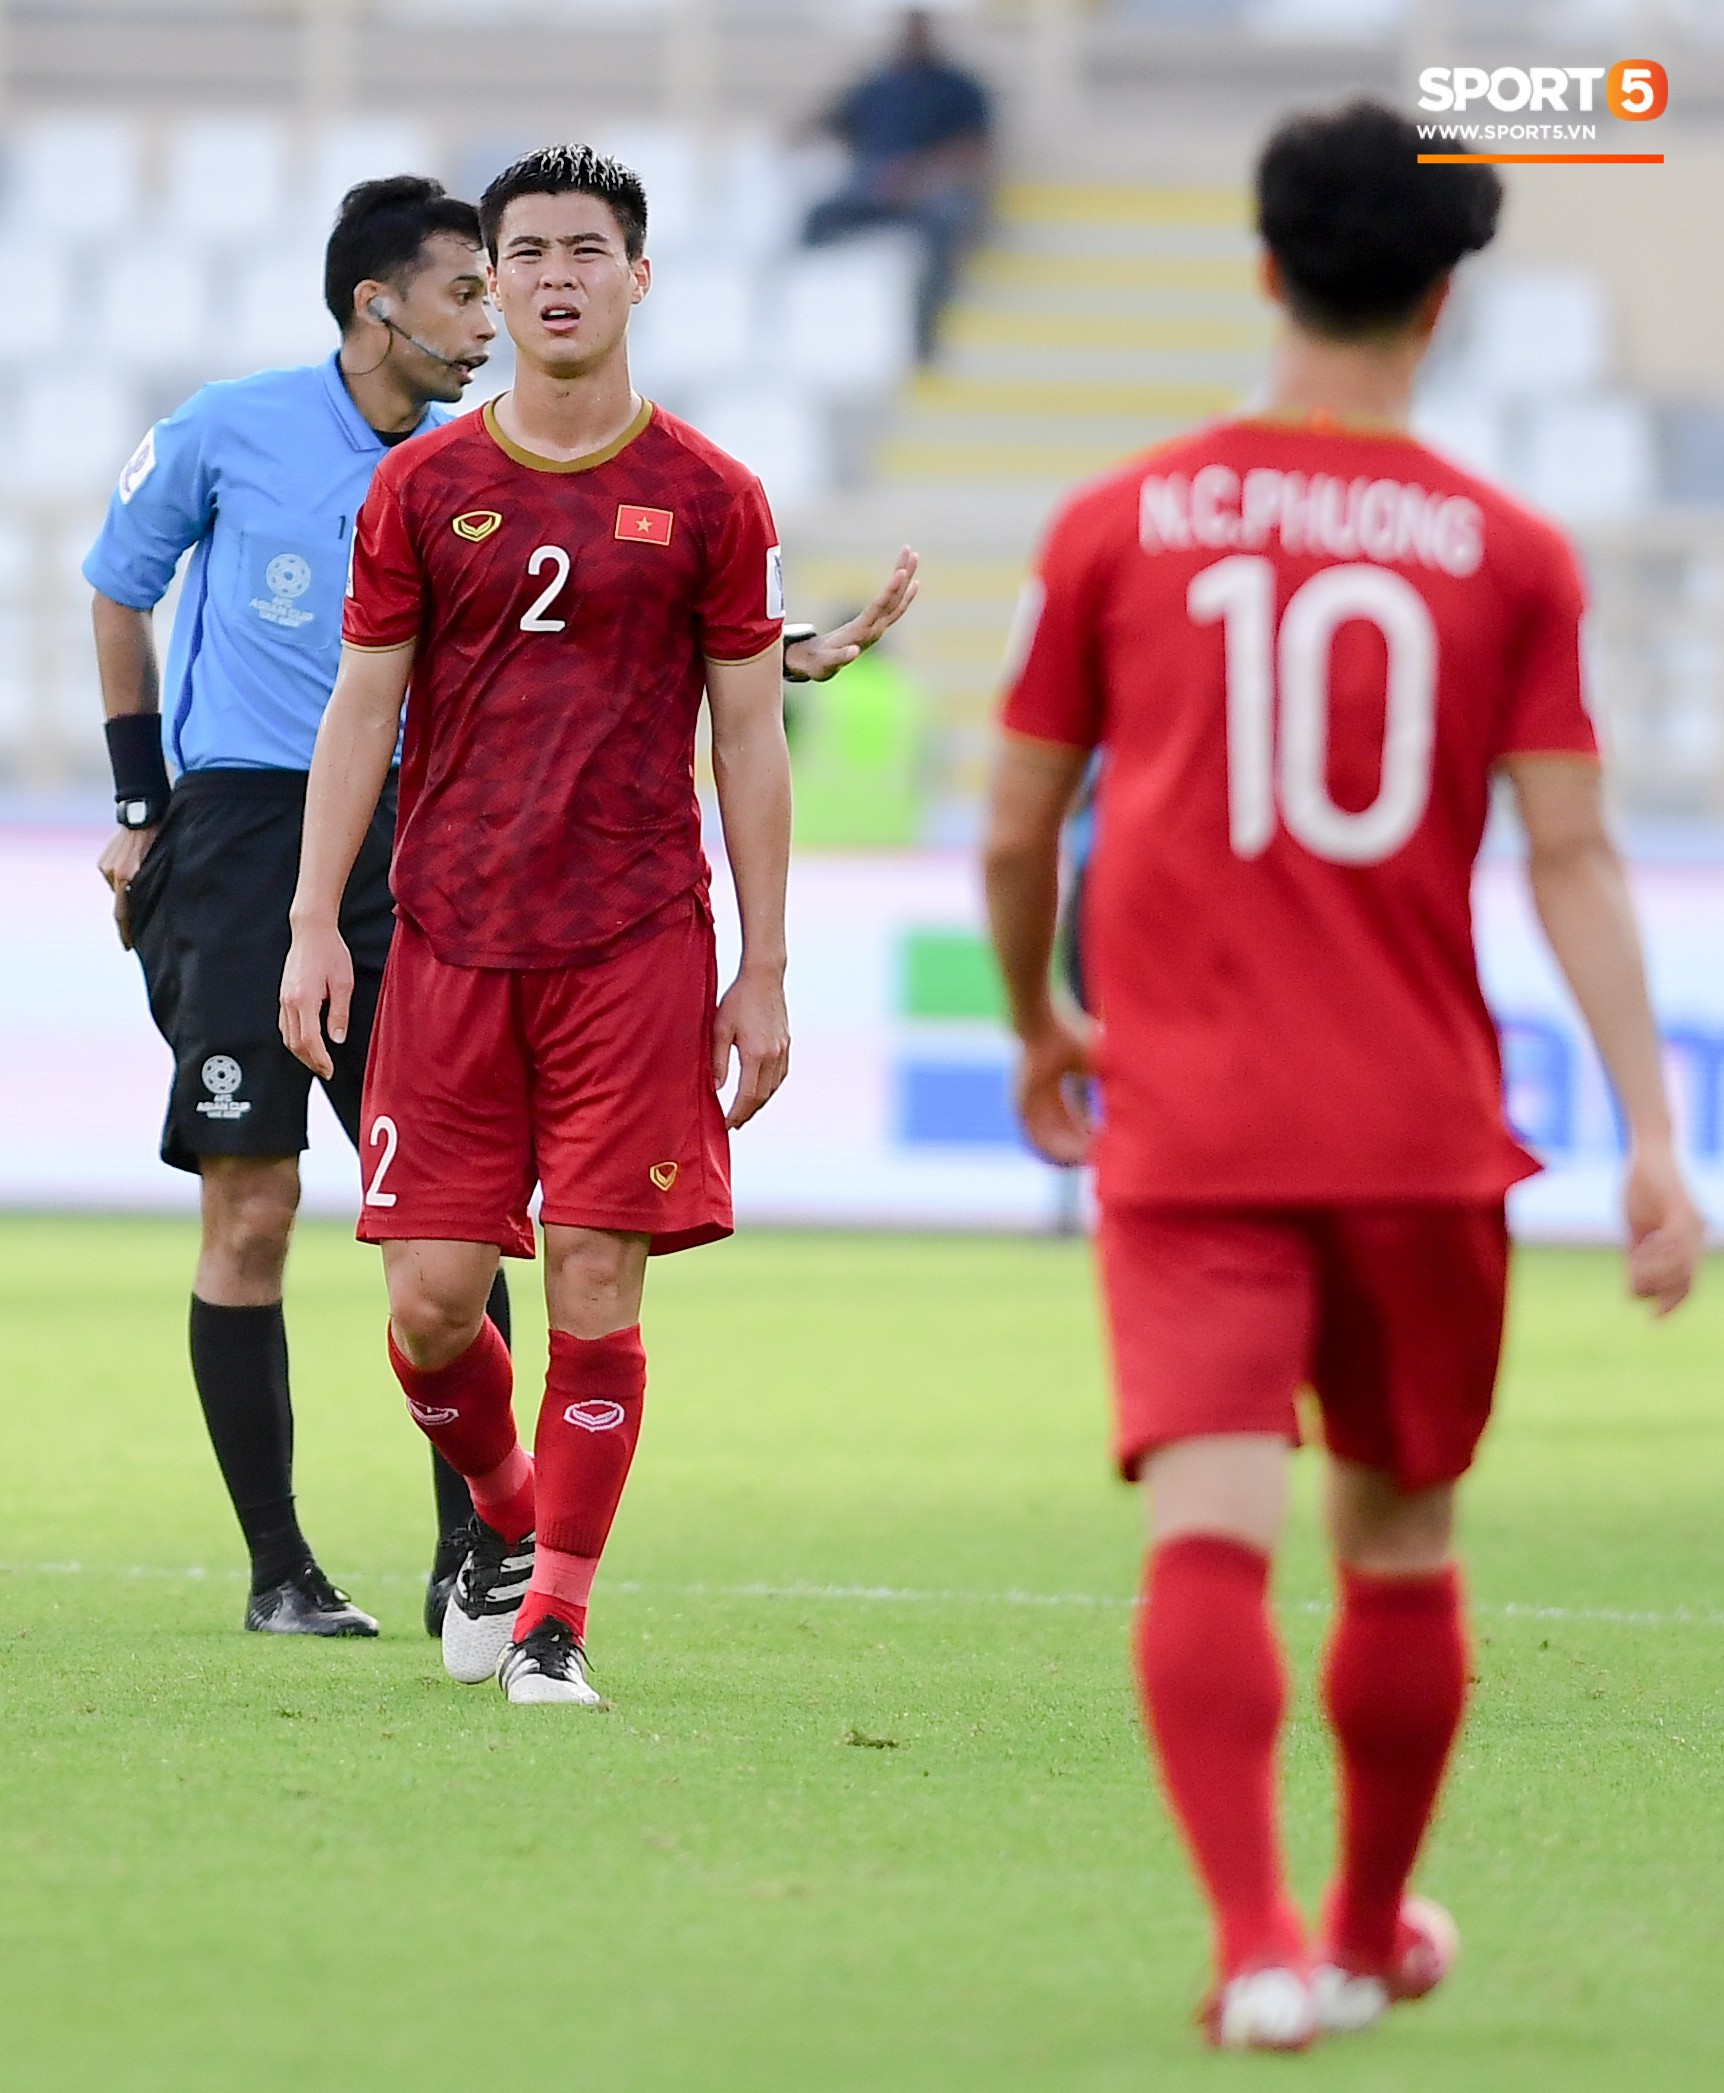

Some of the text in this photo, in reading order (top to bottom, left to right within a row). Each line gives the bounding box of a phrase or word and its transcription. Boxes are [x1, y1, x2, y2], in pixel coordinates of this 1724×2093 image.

[519, 545, 570, 632] 2
[1186, 553, 1440, 867] 10
[365, 1115, 398, 1207] 2
